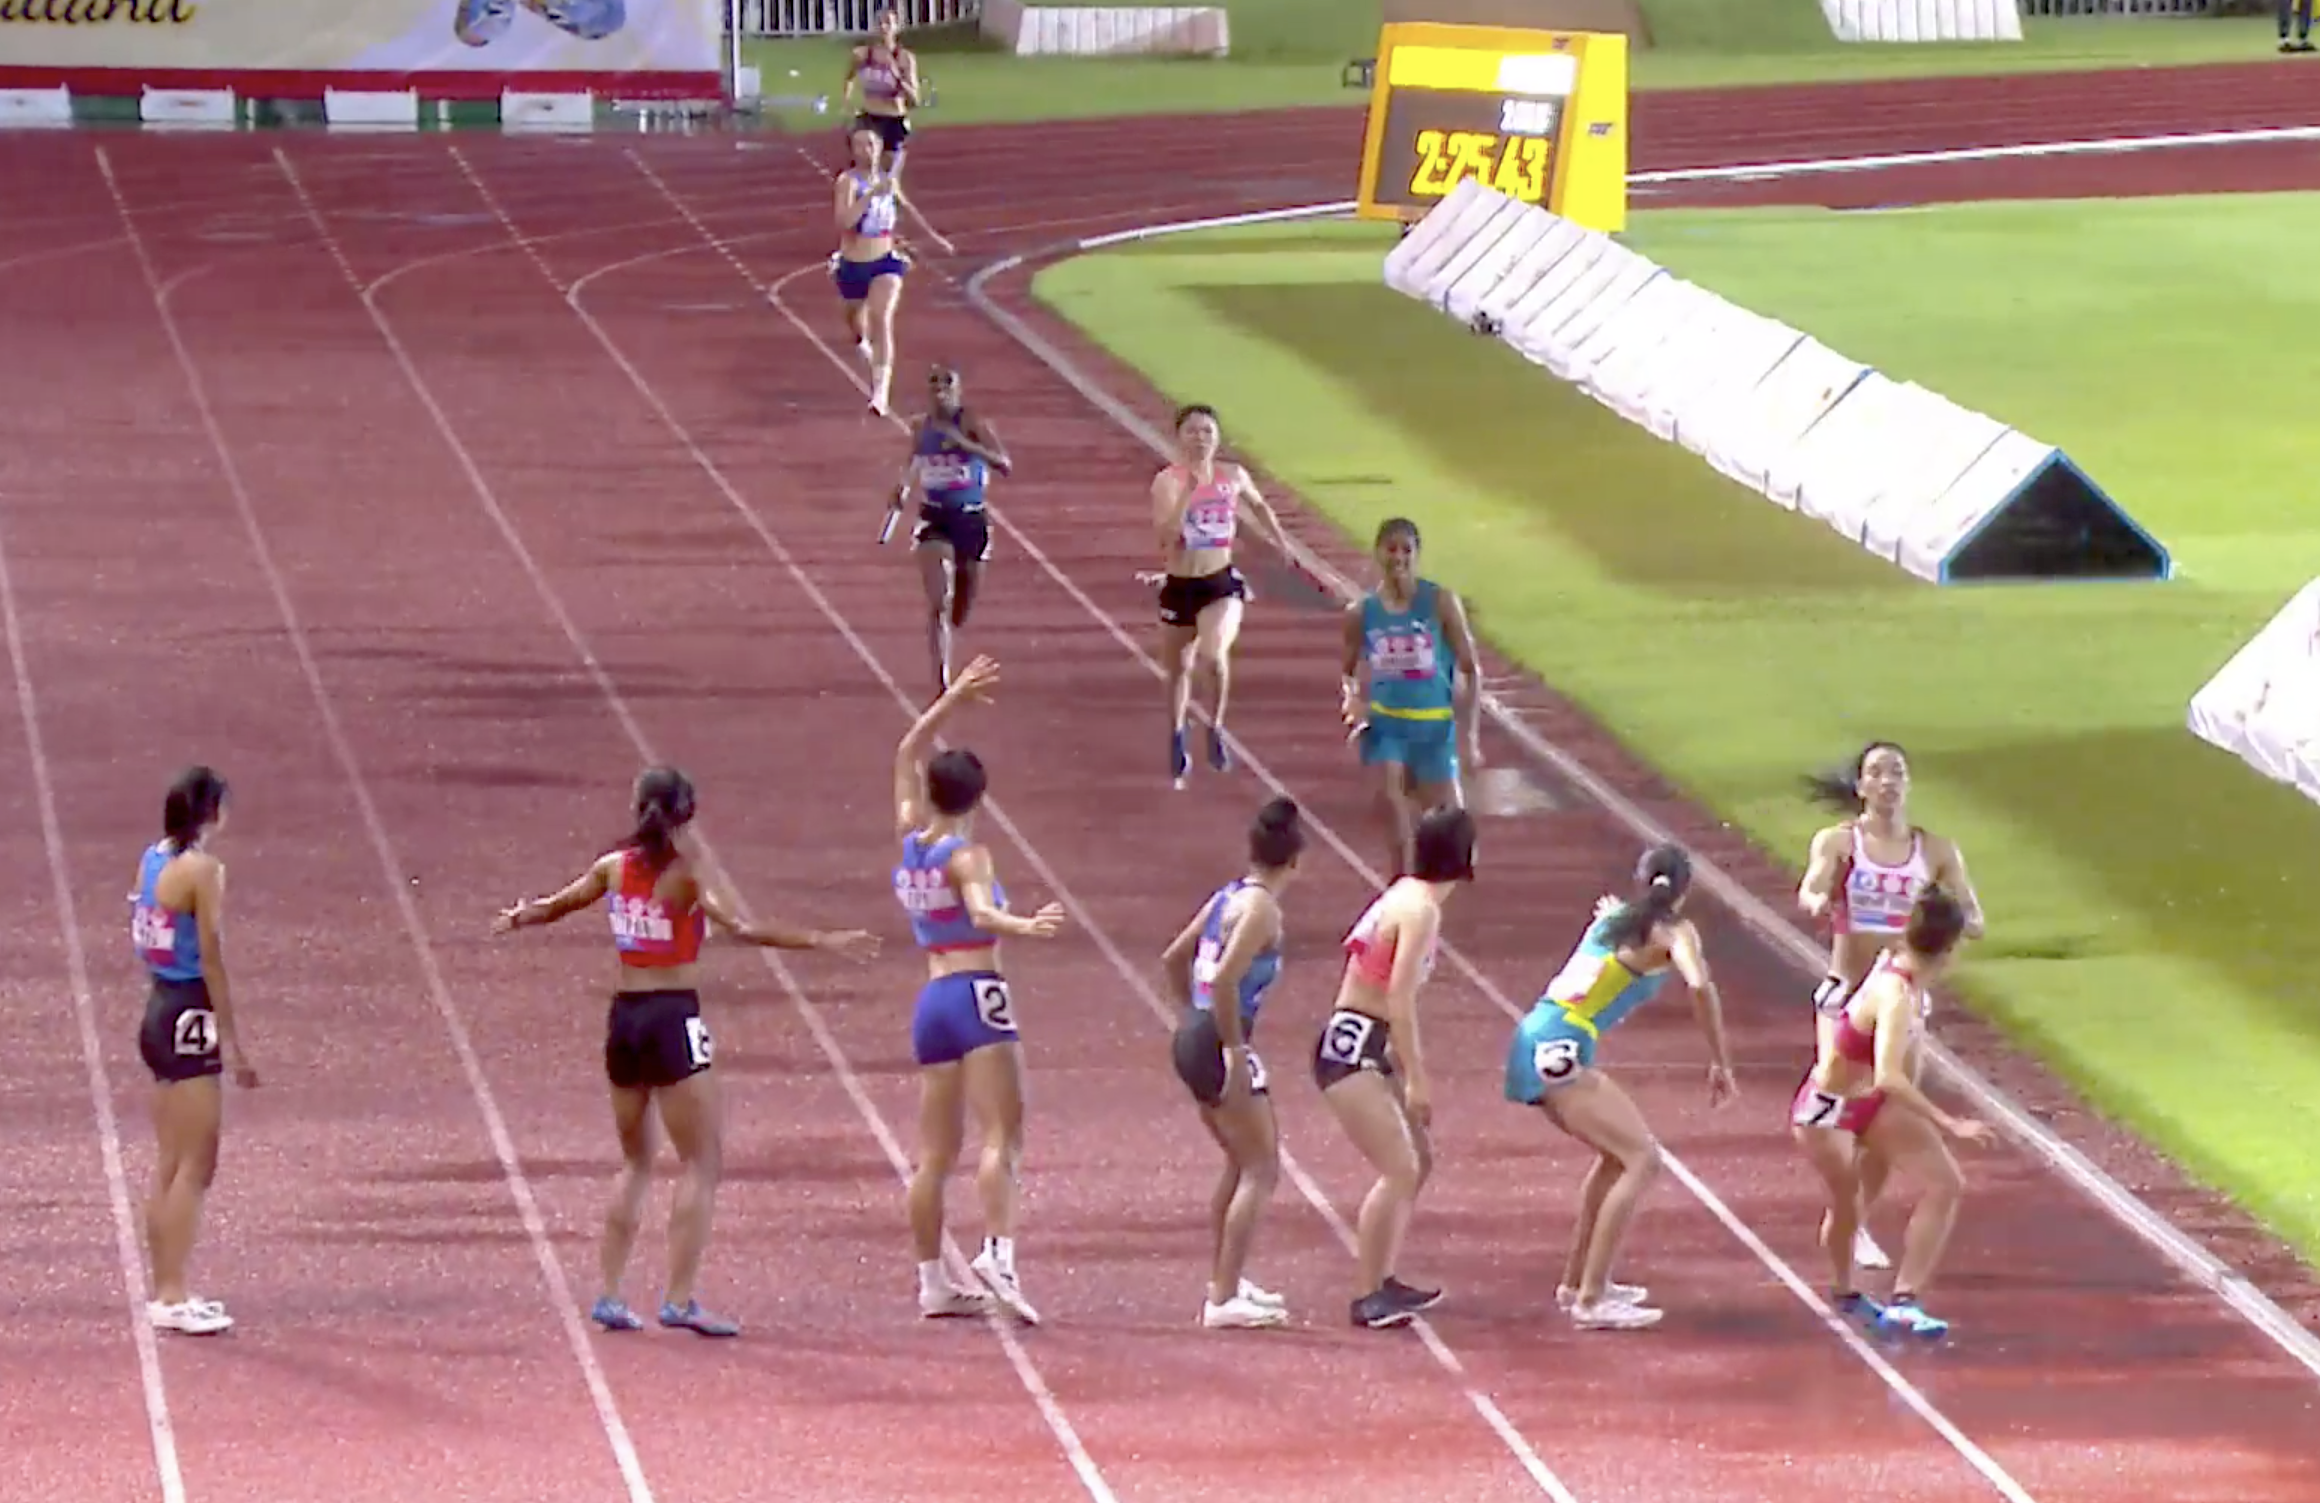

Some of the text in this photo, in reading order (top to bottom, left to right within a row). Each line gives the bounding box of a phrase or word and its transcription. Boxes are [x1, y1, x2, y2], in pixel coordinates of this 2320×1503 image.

[984, 986, 1010, 1025] 2
[181, 1015, 207, 1051] 4
[1331, 1018, 1363, 1058] 6
[1542, 1044, 1574, 1078] 3
[1808, 1093, 1837, 1125] 7
